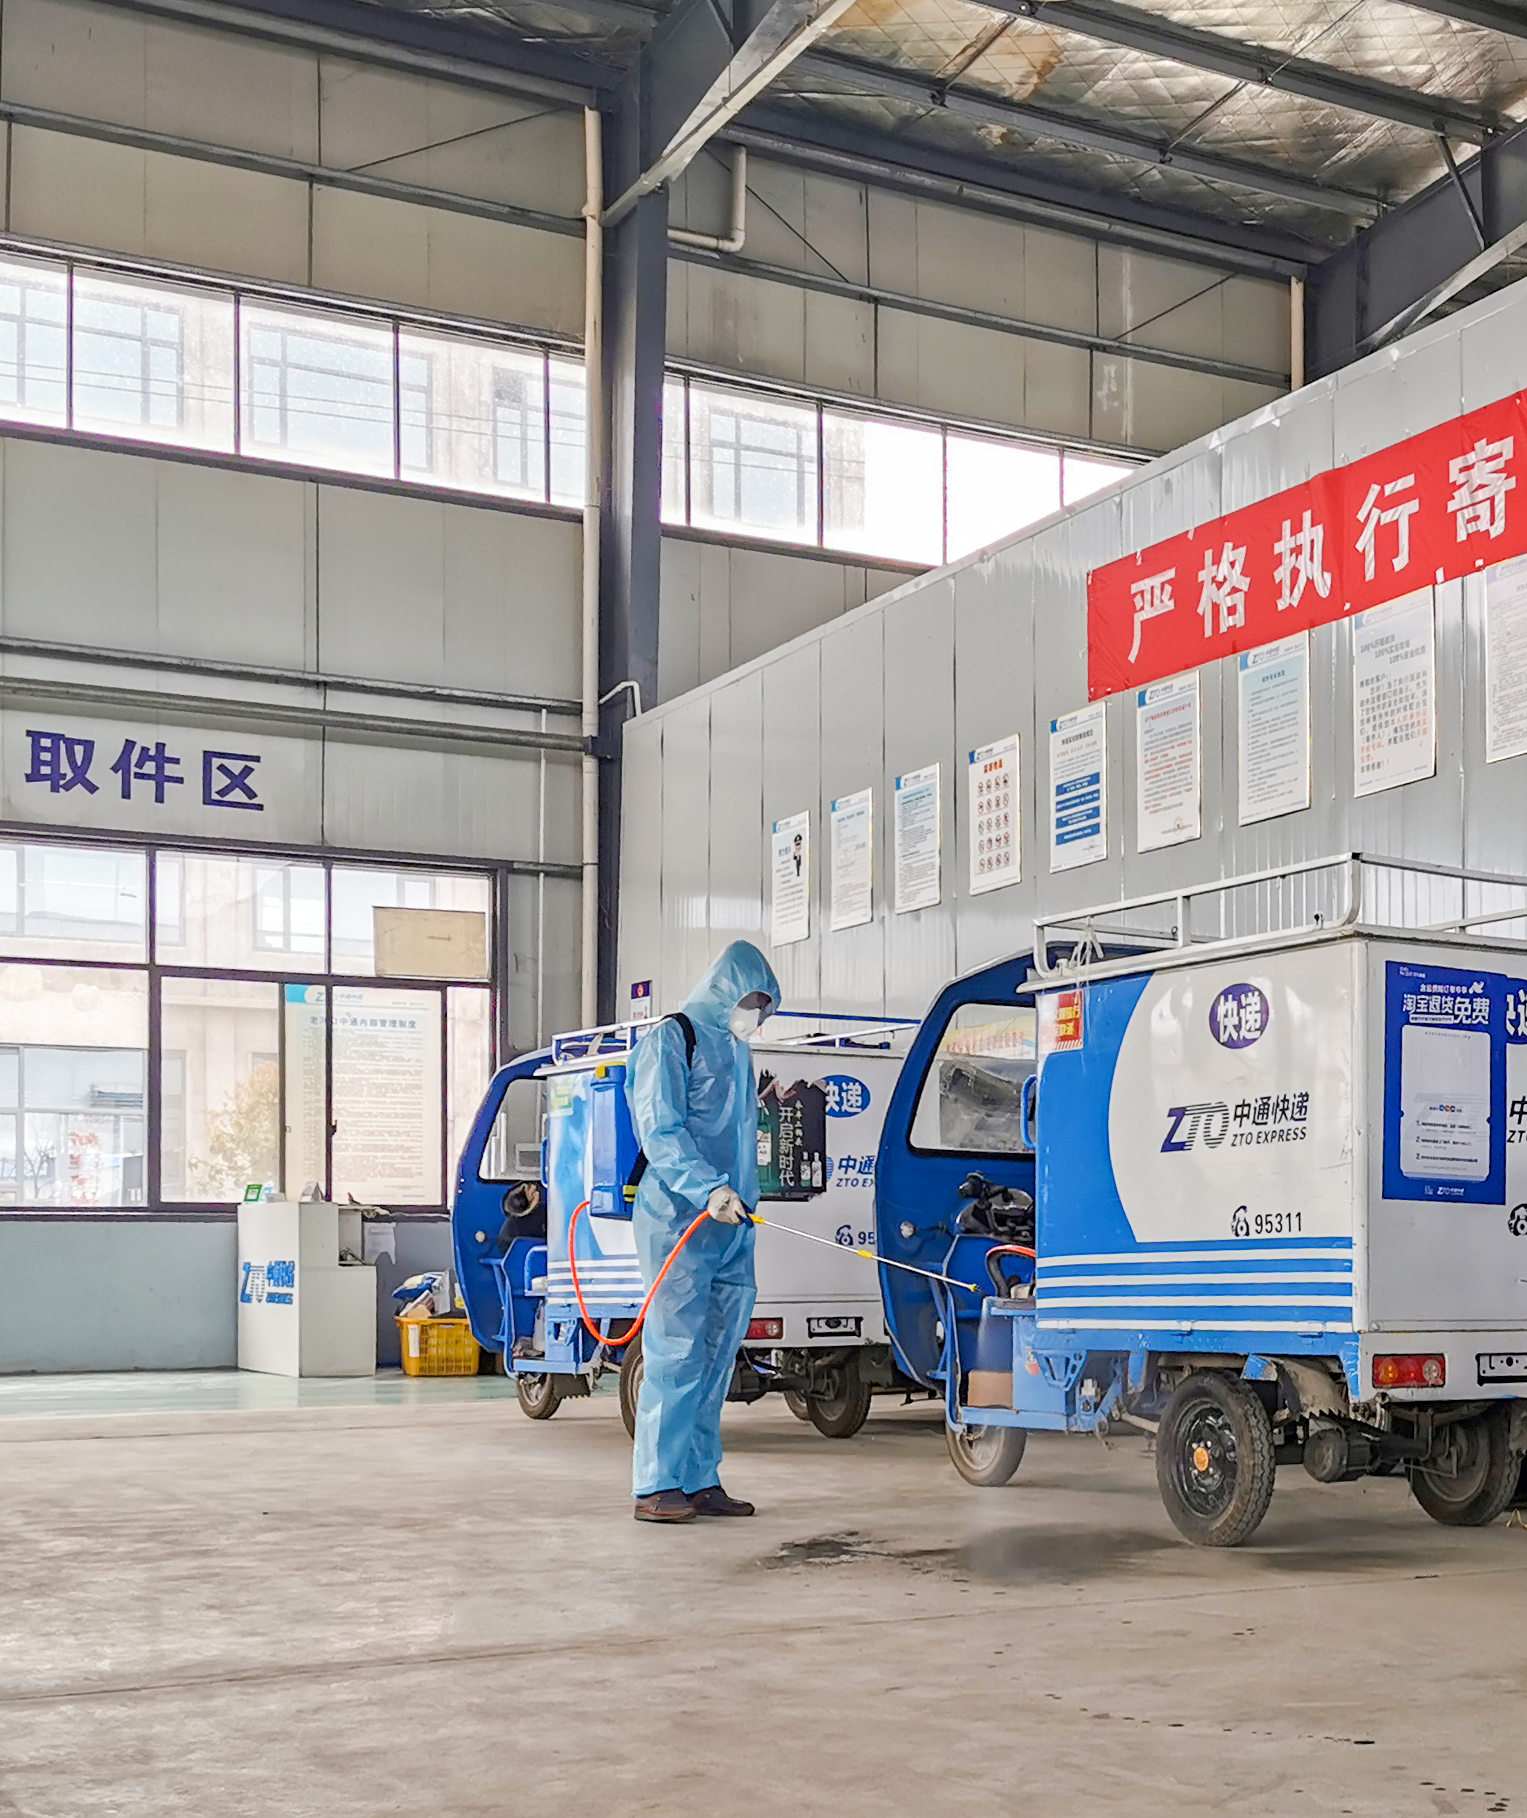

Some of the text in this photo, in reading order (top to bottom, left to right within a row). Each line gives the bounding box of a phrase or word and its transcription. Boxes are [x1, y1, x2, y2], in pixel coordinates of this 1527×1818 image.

[25, 729, 264, 811] 取件区
[1216, 990, 1262, 1043] 快递
[1403, 994, 1490, 1025] 淘宝退货免费
[1160, 1092, 1310, 1153] ZTO 中通快递
[1231, 1126, 1307, 1147] ZTO EXPRESS
[778, 1107, 796, 1187] 开启新时代
[836, 1178, 859, 1187] ZTO
[1254, 1211, 1302, 1234] 95311
